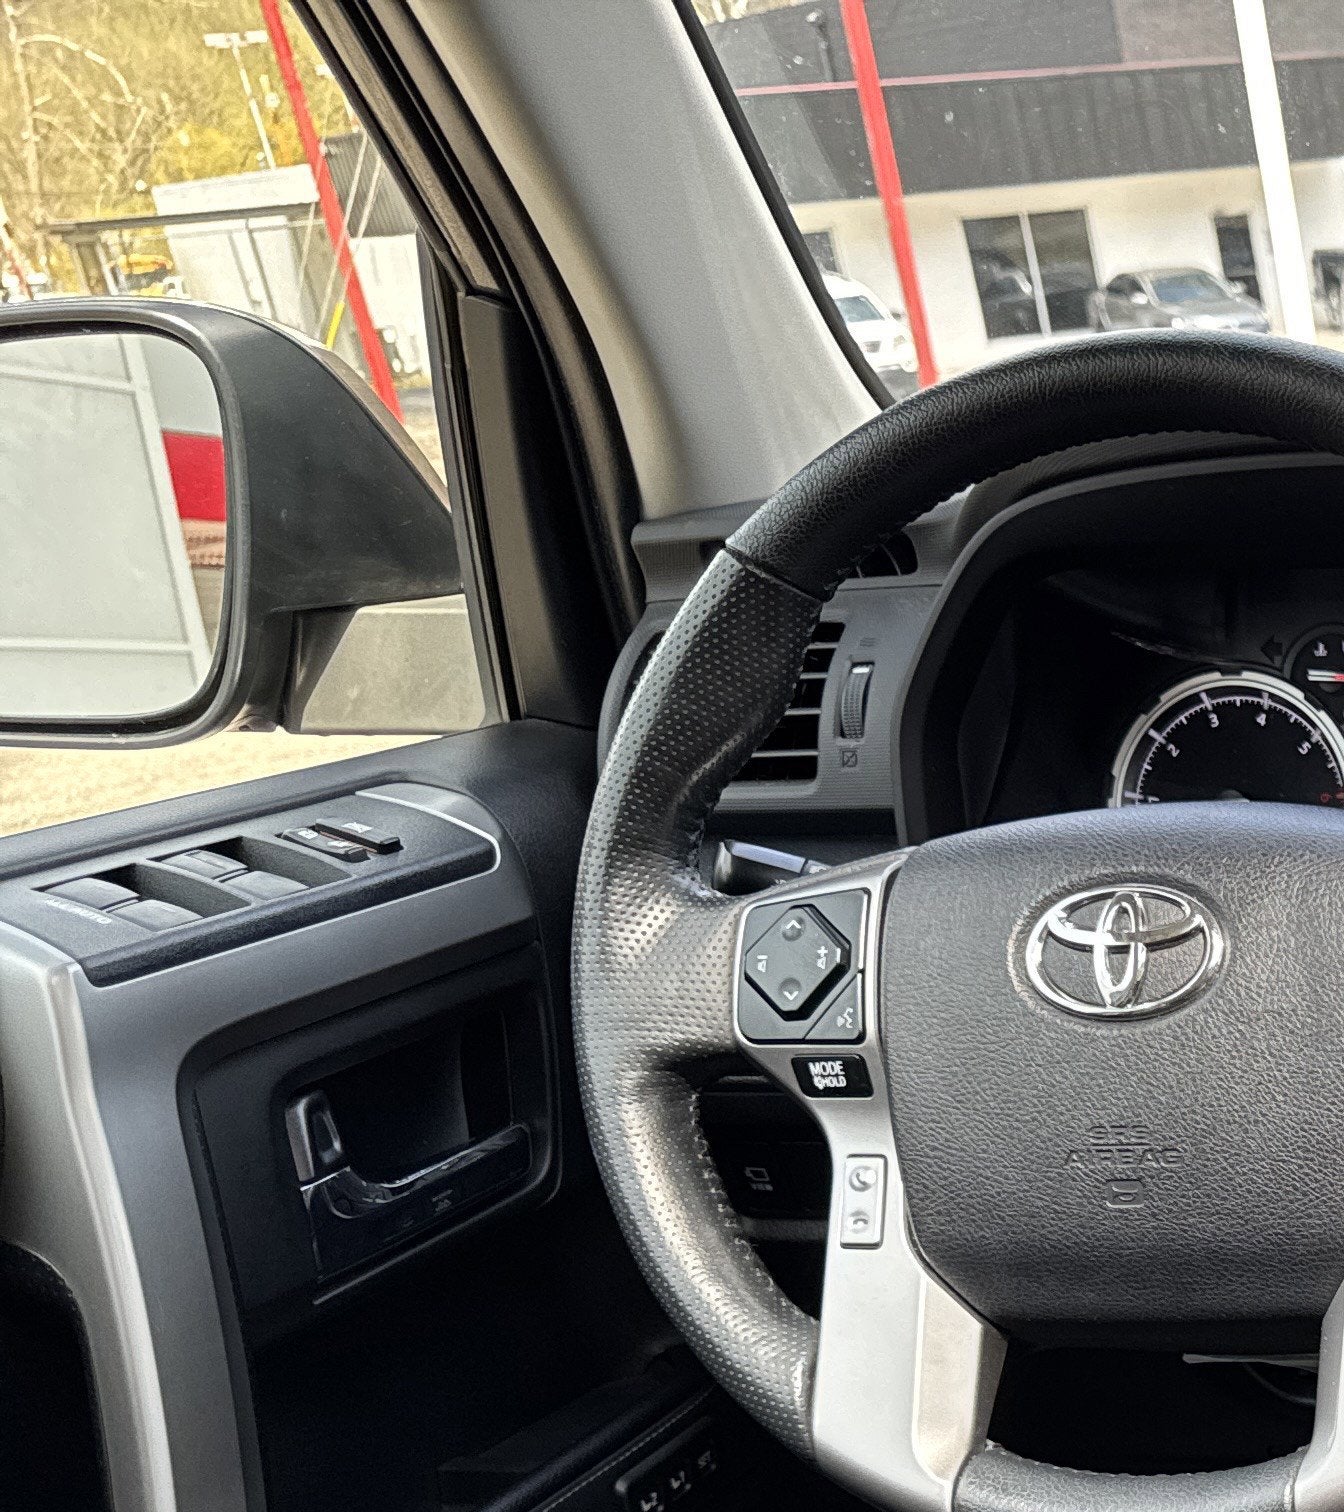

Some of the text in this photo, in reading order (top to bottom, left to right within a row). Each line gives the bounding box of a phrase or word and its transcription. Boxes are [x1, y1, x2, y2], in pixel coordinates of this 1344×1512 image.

[1210, 713, 1220, 728] 3
[1256, 713, 1267, 727] 4
[1166, 744, 1180, 757] 2
[1298, 743, 1312, 755] 5
[809, 1061, 845, 1076] MODE
